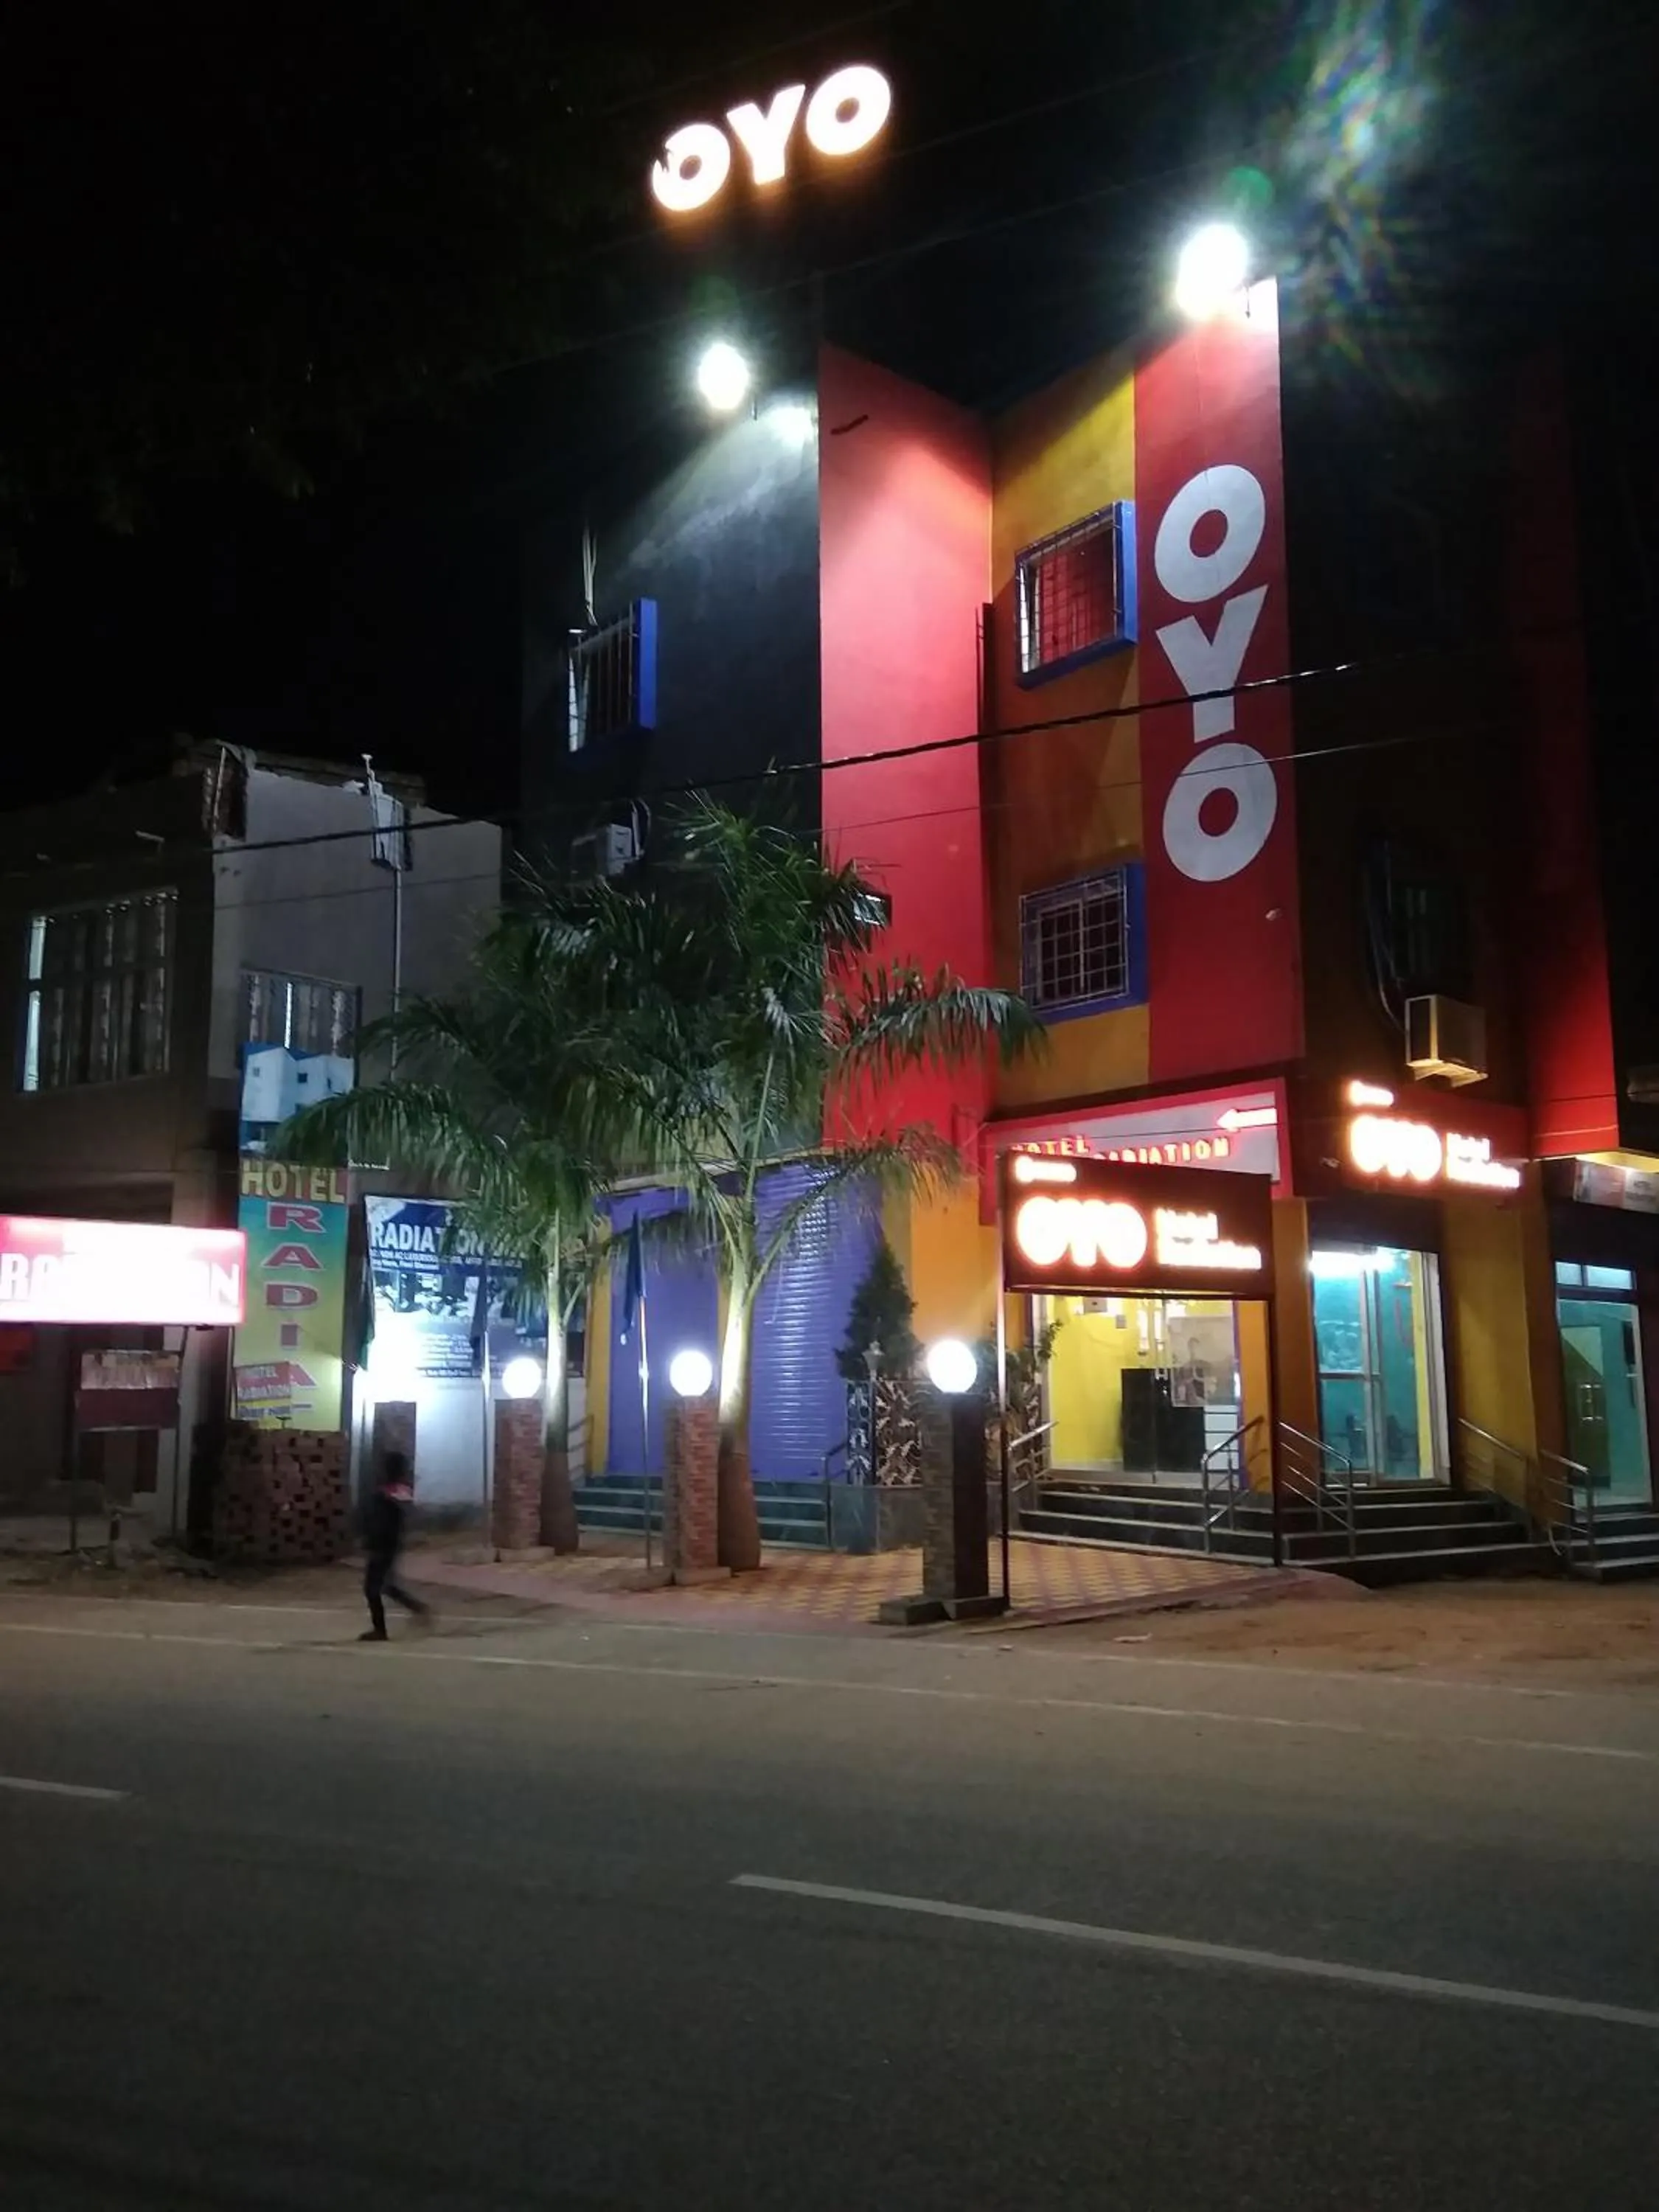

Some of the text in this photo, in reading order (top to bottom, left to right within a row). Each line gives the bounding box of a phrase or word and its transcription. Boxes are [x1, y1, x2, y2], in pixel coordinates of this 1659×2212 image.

[651, 65, 891, 212] OYO
[1154, 464, 1278, 883] OYO
[1012, 1135, 1089, 1155] OTEL
[1093, 1137, 1231, 1164] ADIATION
[241, 1159, 345, 1203] HOTEL
[372, 1221, 484, 1256] RADIATON
